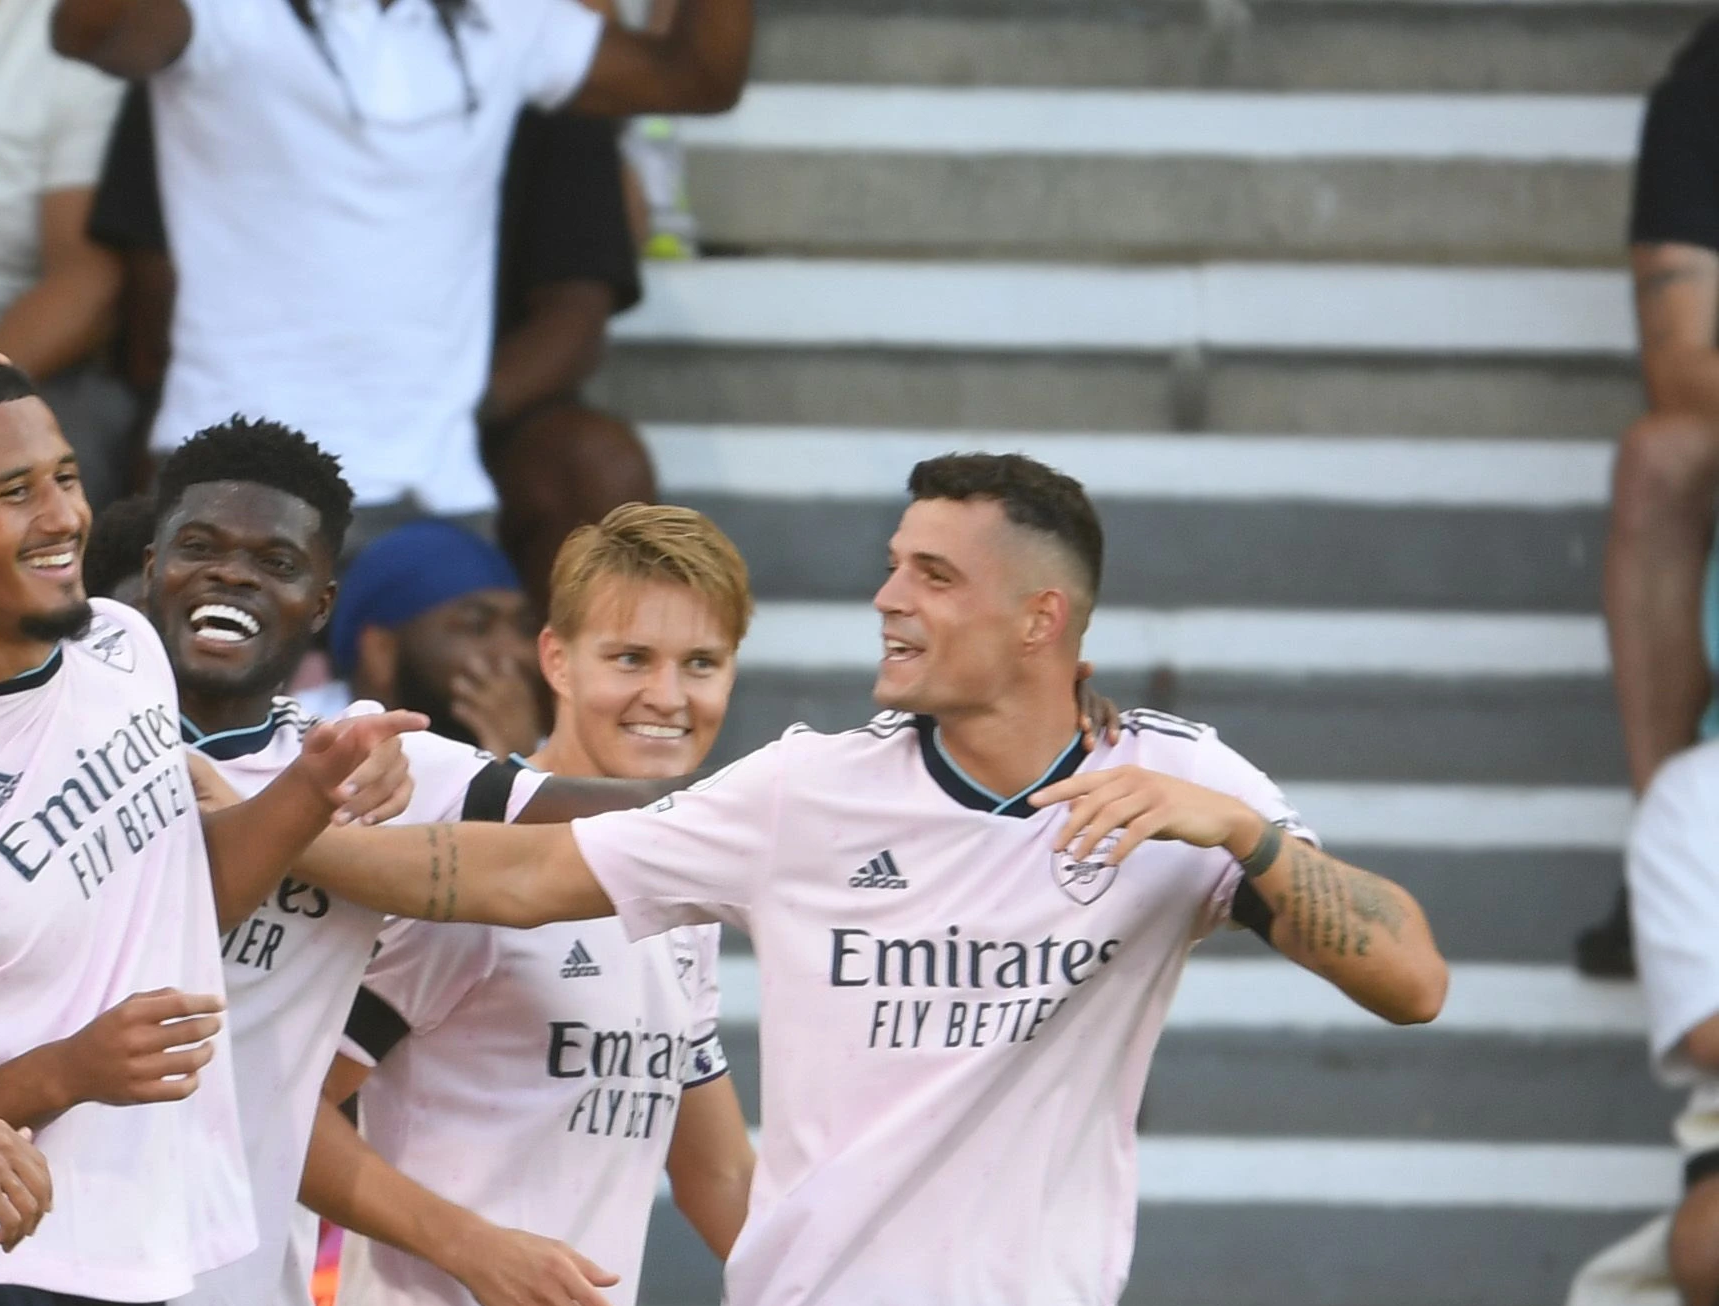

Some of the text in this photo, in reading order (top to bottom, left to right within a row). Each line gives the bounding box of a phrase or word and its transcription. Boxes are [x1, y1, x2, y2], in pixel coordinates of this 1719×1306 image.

[69, 824, 114, 901] FLY
[868, 998, 1069, 1049] FLY BETTE
